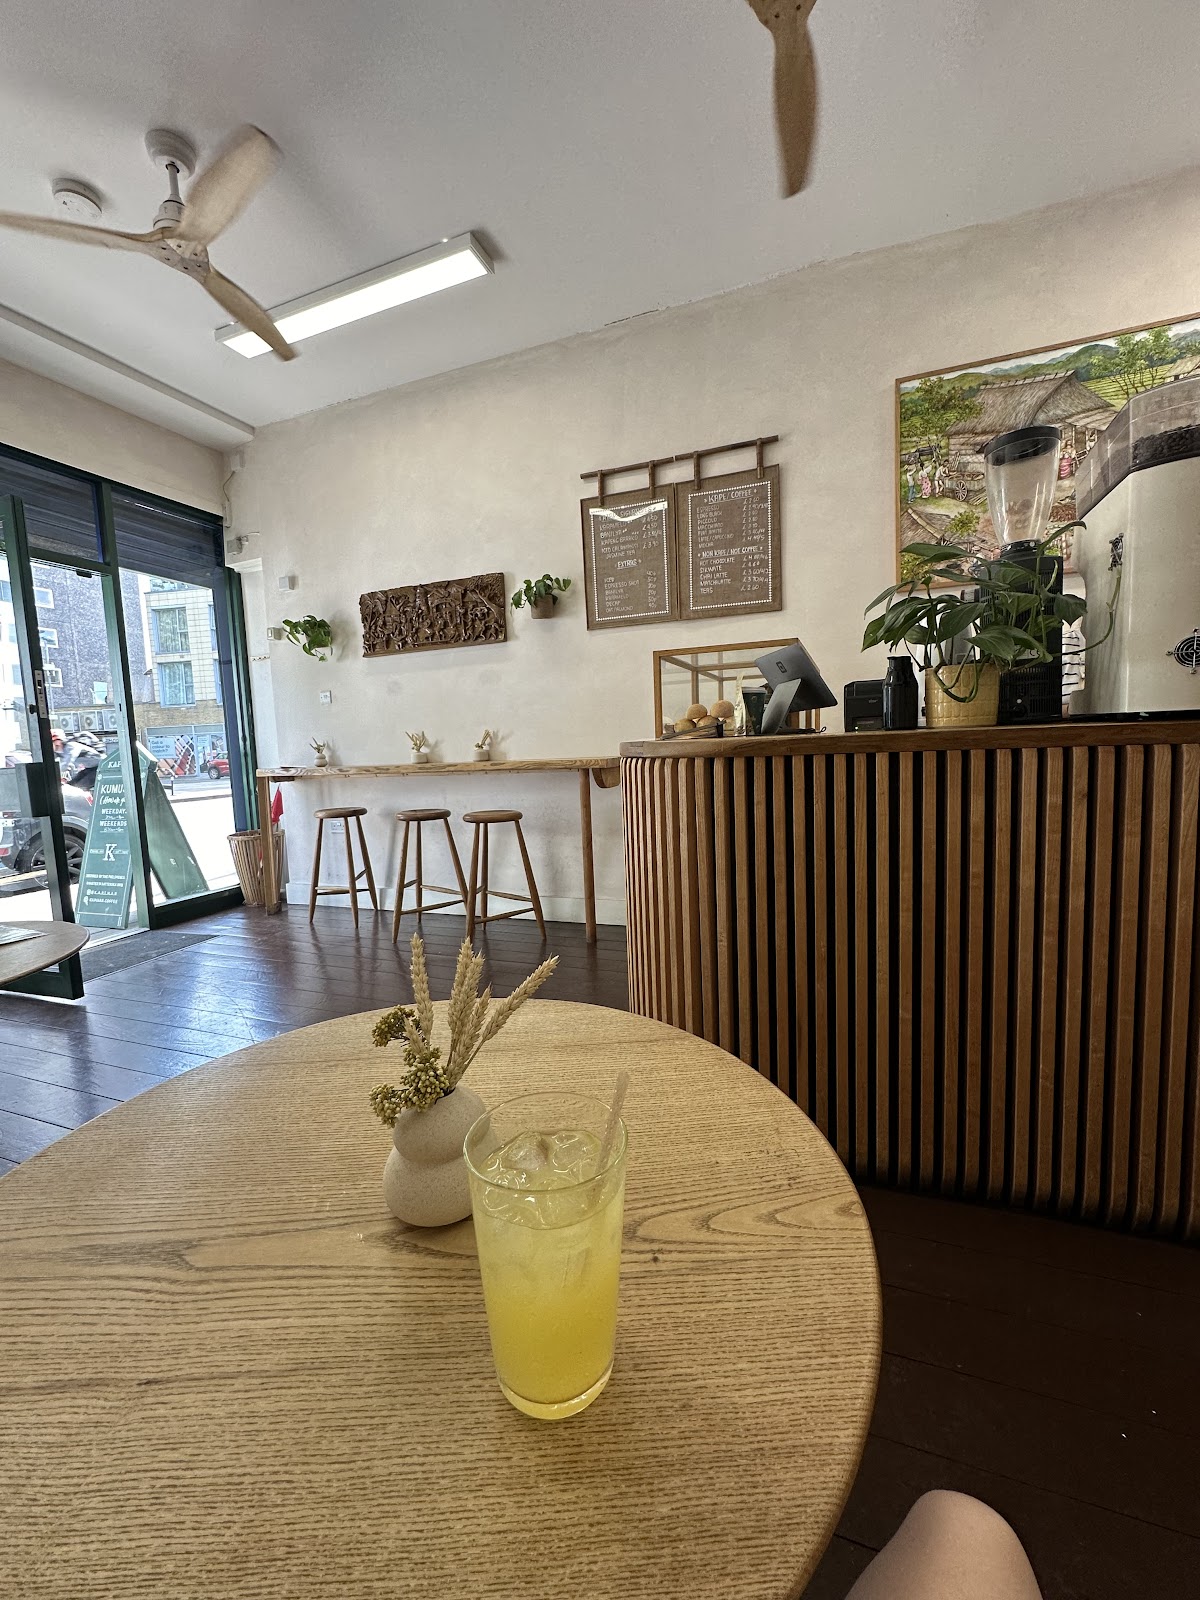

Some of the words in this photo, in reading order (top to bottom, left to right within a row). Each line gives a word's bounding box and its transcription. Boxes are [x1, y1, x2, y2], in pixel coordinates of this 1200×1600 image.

[697, 505, 719, 513] ESPRESSO
[698, 518, 717, 526] PICCOLO
[617, 559, 637, 568] EXTRAS
[100, 784, 125, 794] KUMU
[103, 844, 118, 861] K
